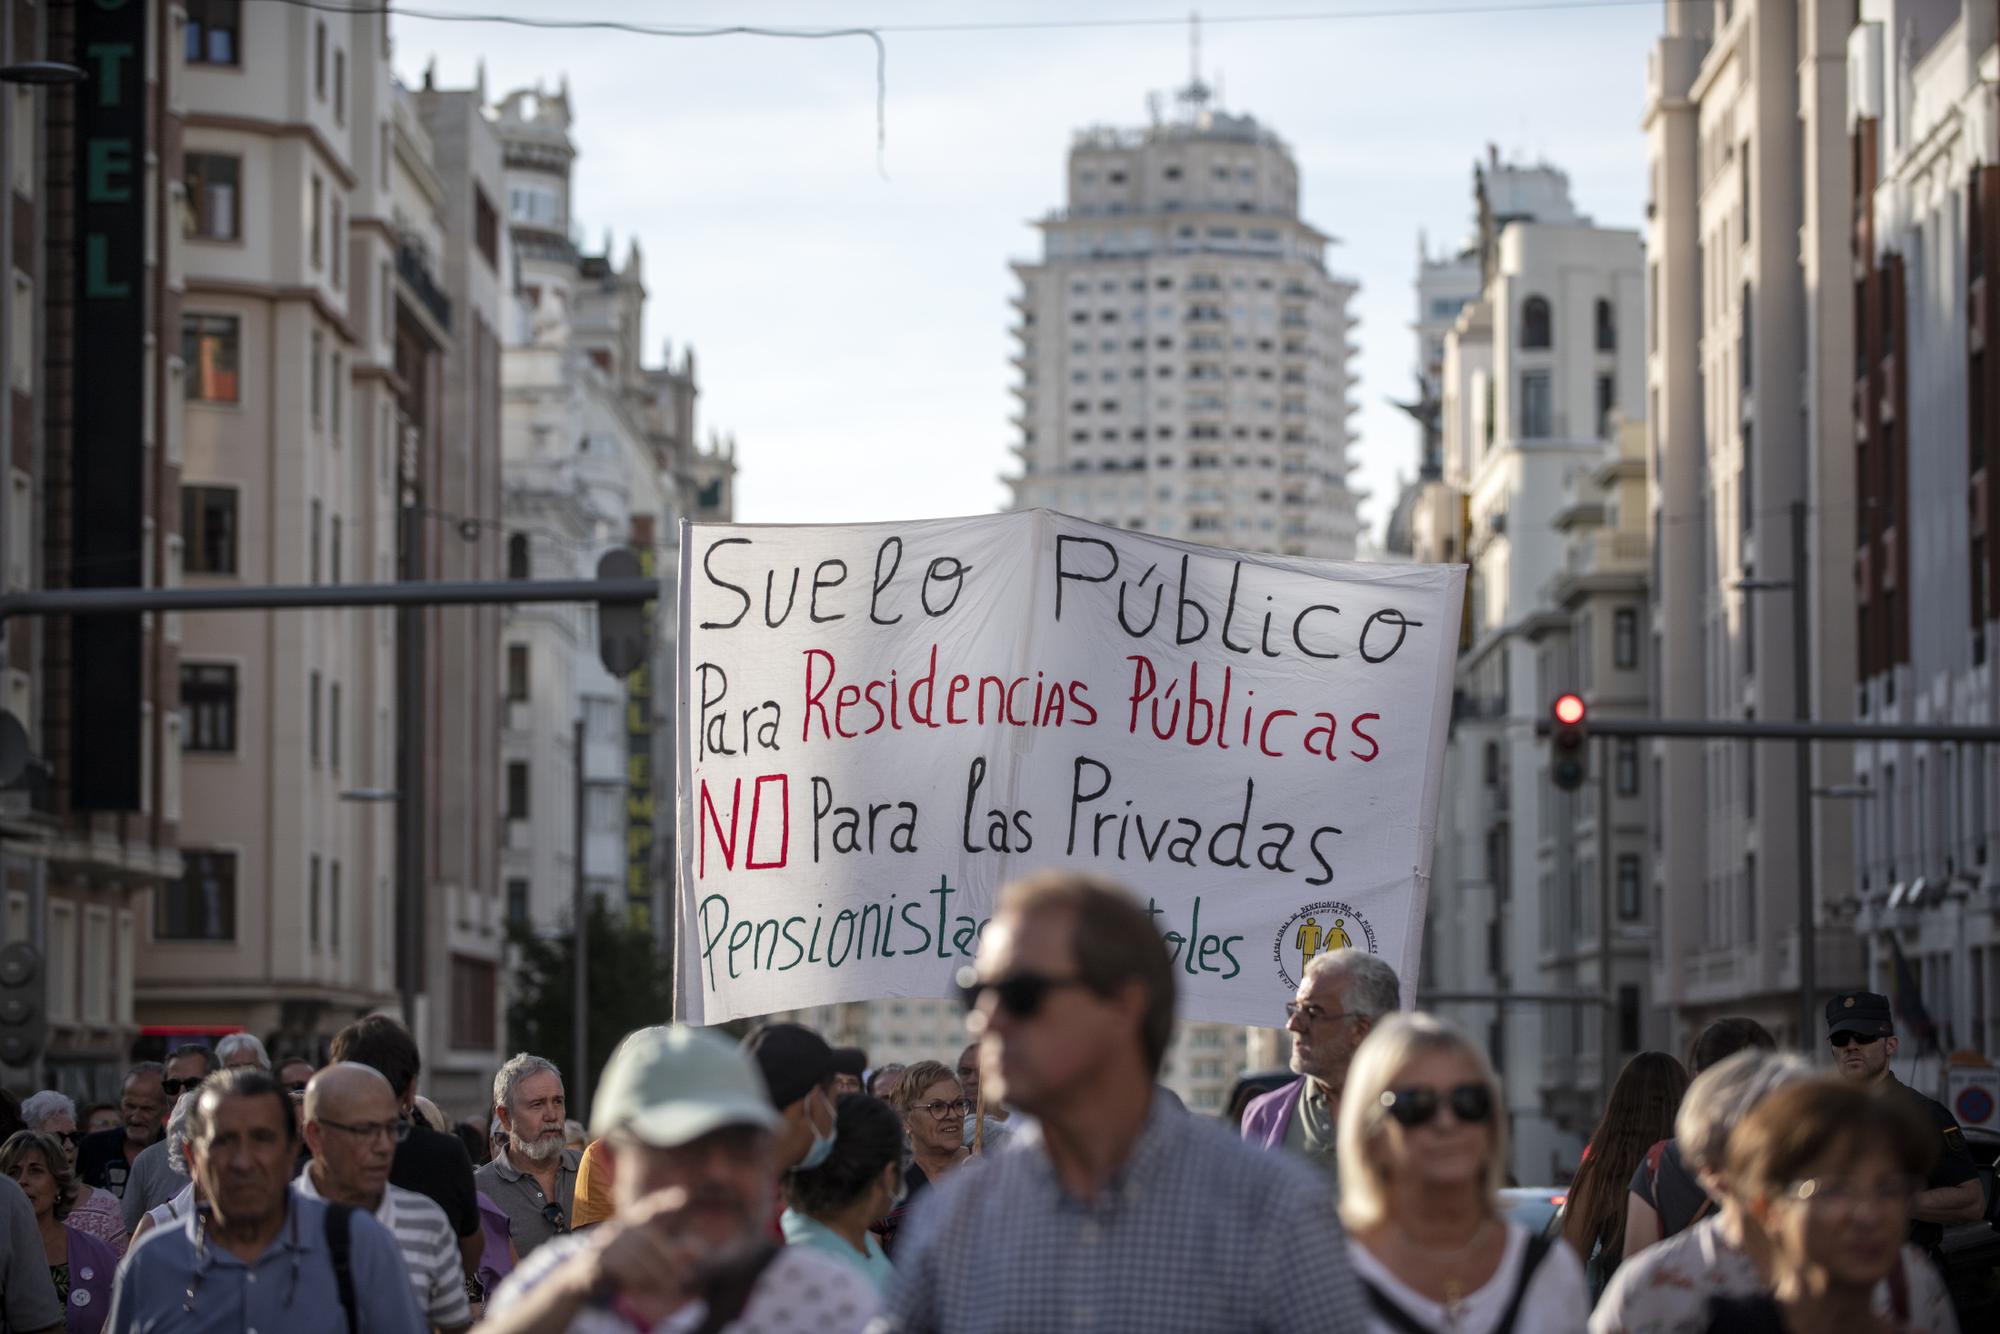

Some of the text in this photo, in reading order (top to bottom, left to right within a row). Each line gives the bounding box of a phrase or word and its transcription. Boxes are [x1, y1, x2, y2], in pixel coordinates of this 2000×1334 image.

[86, 0, 133, 298] TEL
[699, 534, 1424, 663] Suelo Público
[695, 661, 781, 762] Para
[1126, 655, 1381, 762] Públicas
[699, 755, 1343, 886] NO Para las Privadas
[1276, 969, 1297, 992] PENSI
